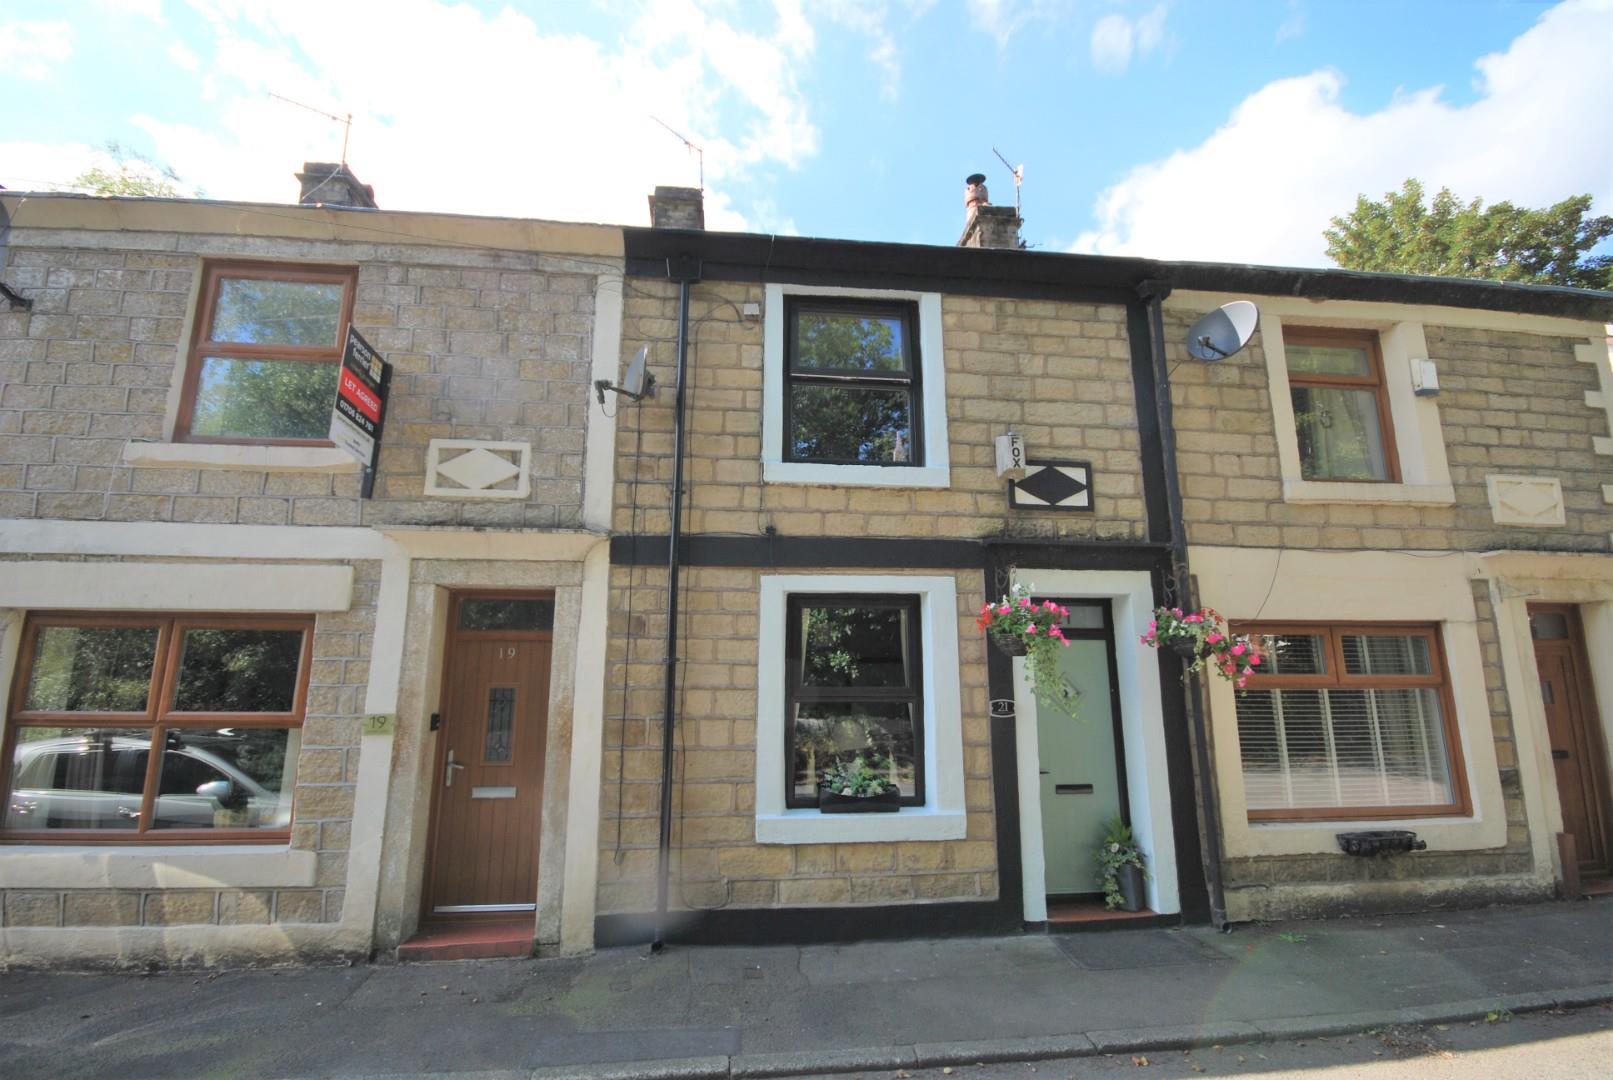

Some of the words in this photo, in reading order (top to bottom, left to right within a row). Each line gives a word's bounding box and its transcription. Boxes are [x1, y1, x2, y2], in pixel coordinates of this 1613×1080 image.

[344, 377, 356, 392] LET
[356, 389, 377, 412] AGREED
[1011, 436, 1021, 468] FOX
[499, 647, 516, 660] 19
[998, 701, 1008, 712] 21
[369, 715, 386, 729] 19
